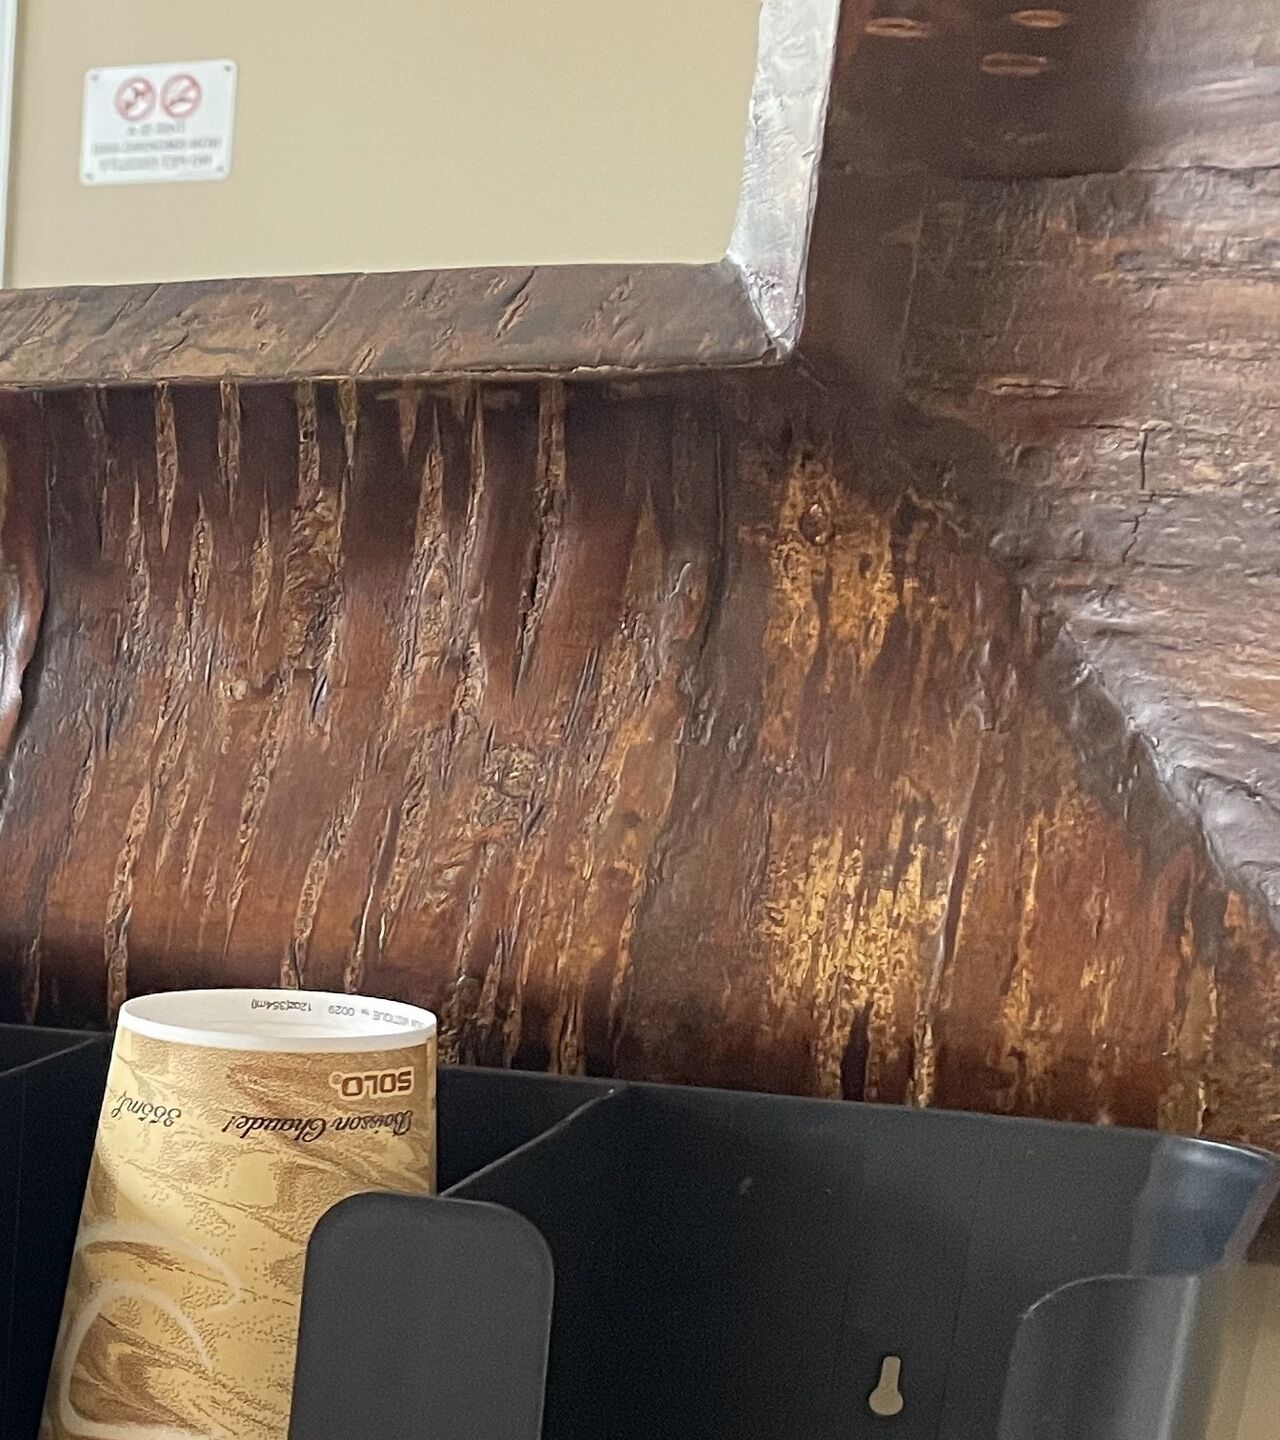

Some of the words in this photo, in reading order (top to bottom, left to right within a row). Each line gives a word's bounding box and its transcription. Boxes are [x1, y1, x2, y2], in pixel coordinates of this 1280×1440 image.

[327, 1005, 356, 1017] 0029
[341, 1070, 413, 1097] SOLO
[220, 1114, 328, 1143] Chaude!
[330, 1109, 414, 1137] Boisson
